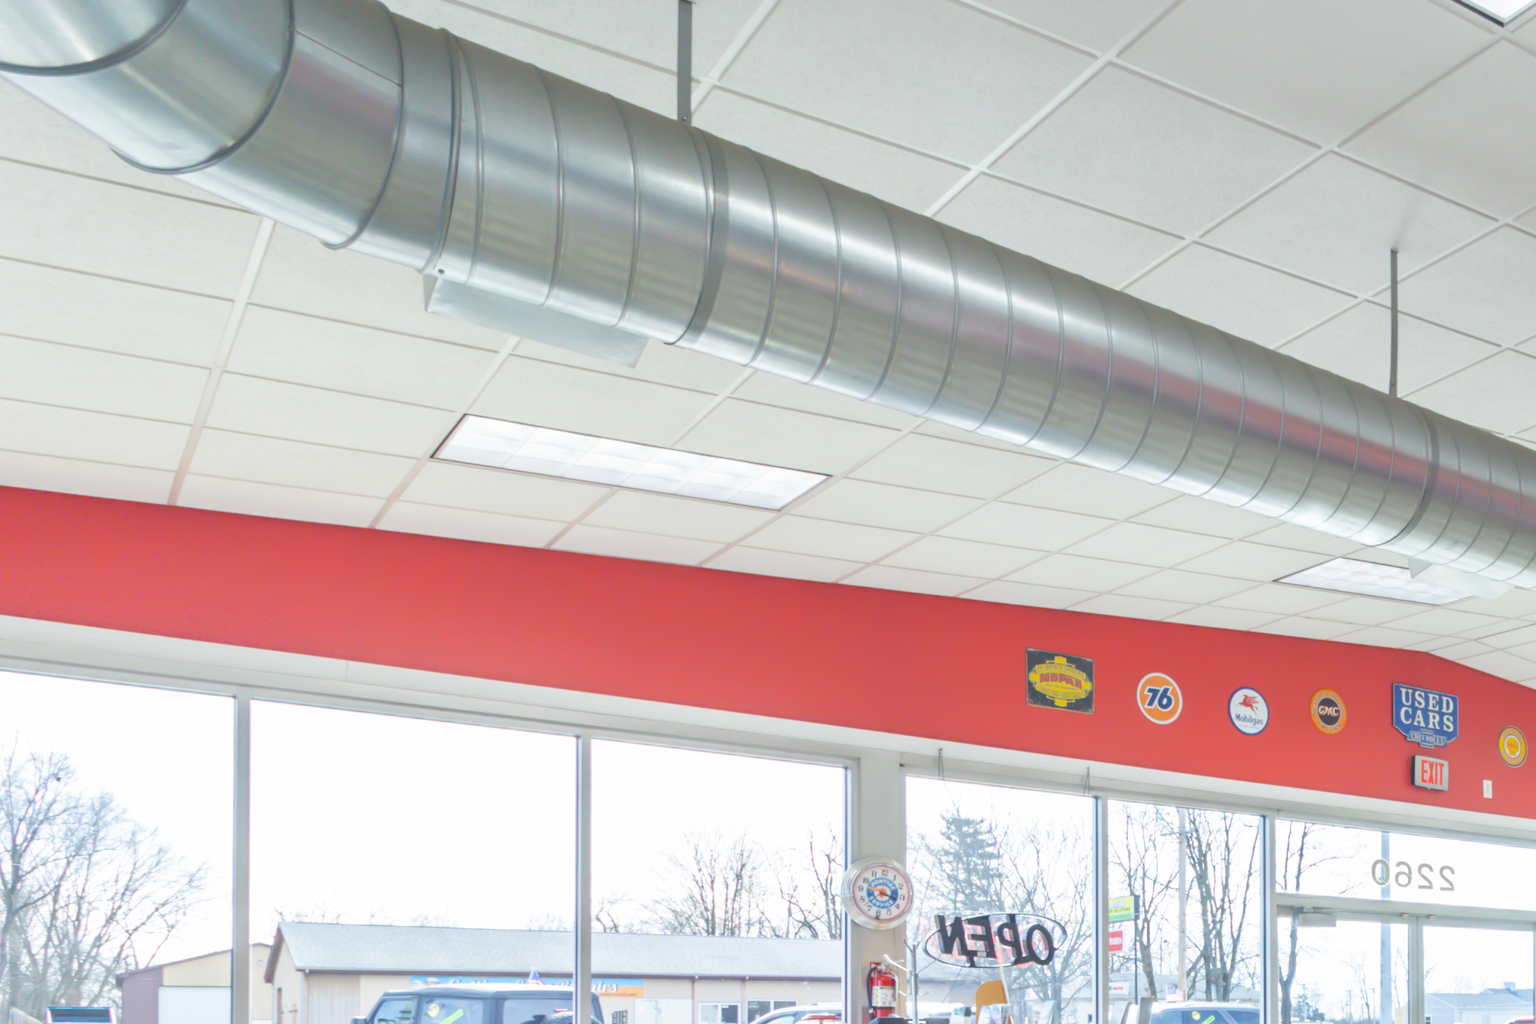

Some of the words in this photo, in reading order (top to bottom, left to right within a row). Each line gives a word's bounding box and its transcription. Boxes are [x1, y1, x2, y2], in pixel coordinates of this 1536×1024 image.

[1144, 685, 1175, 712] 76
[1318, 705, 1339, 717] GMC
[1400, 687, 1454, 714] USED
[1235, 713, 1264, 726] Mobilgas
[1400, 706, 1454, 732] CARS
[1420, 759, 1445, 786] EXIT
